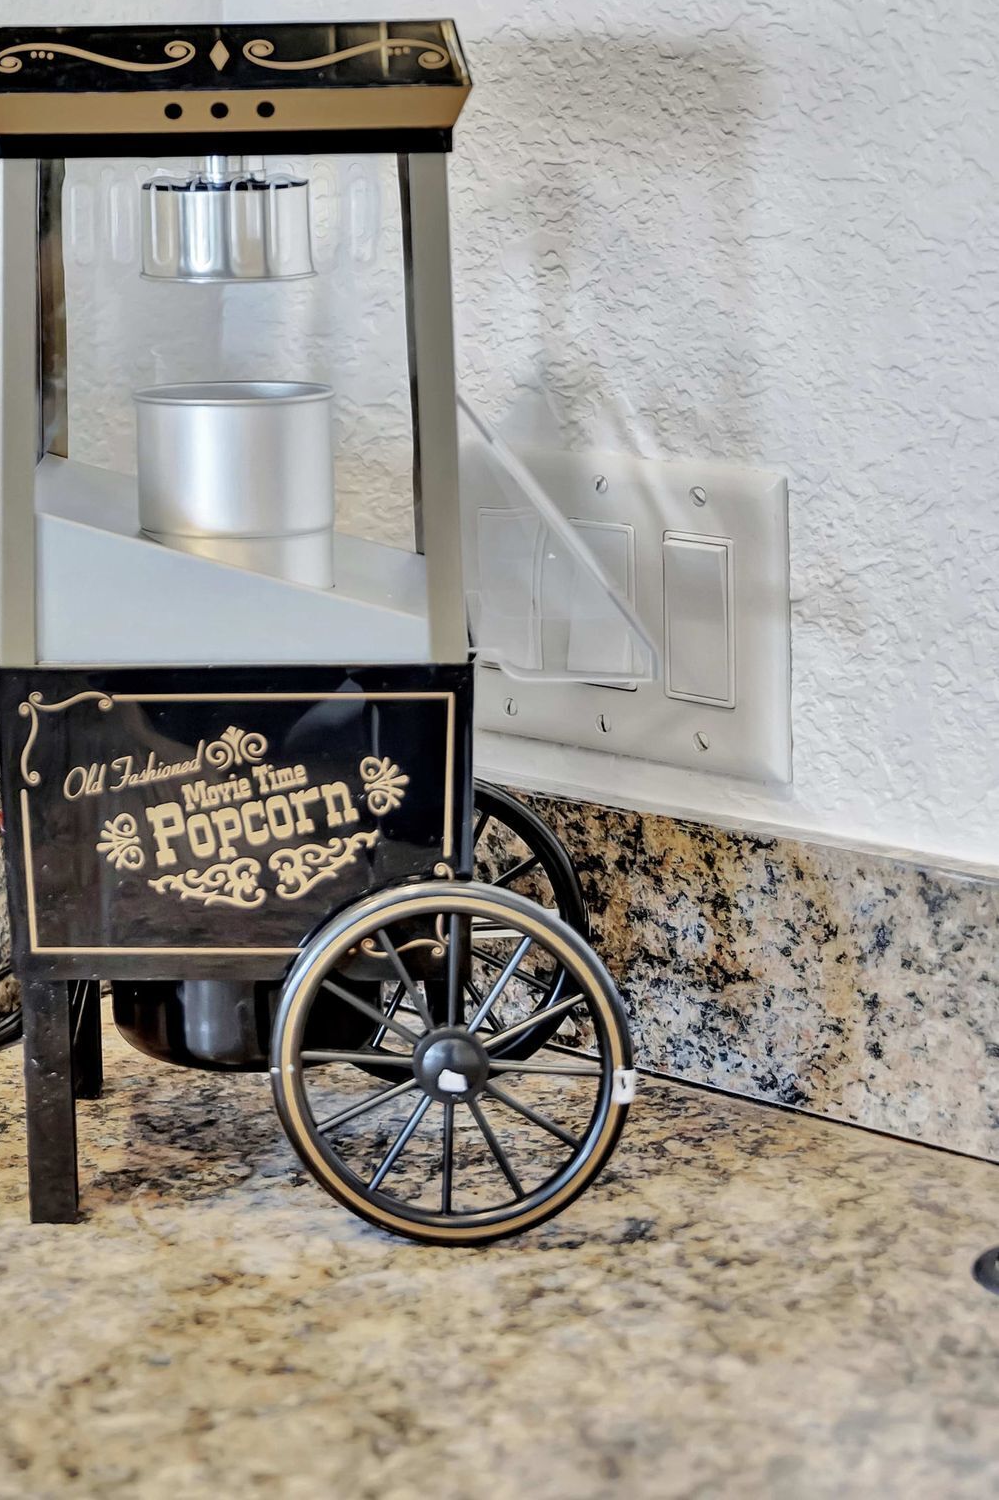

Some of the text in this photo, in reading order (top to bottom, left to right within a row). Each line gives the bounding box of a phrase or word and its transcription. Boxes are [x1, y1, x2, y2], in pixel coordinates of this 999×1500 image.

[63, 740, 206, 801] Old Fashioned
[181, 761, 308, 814] Movie Time
[146, 779, 360, 868] Popcorn
